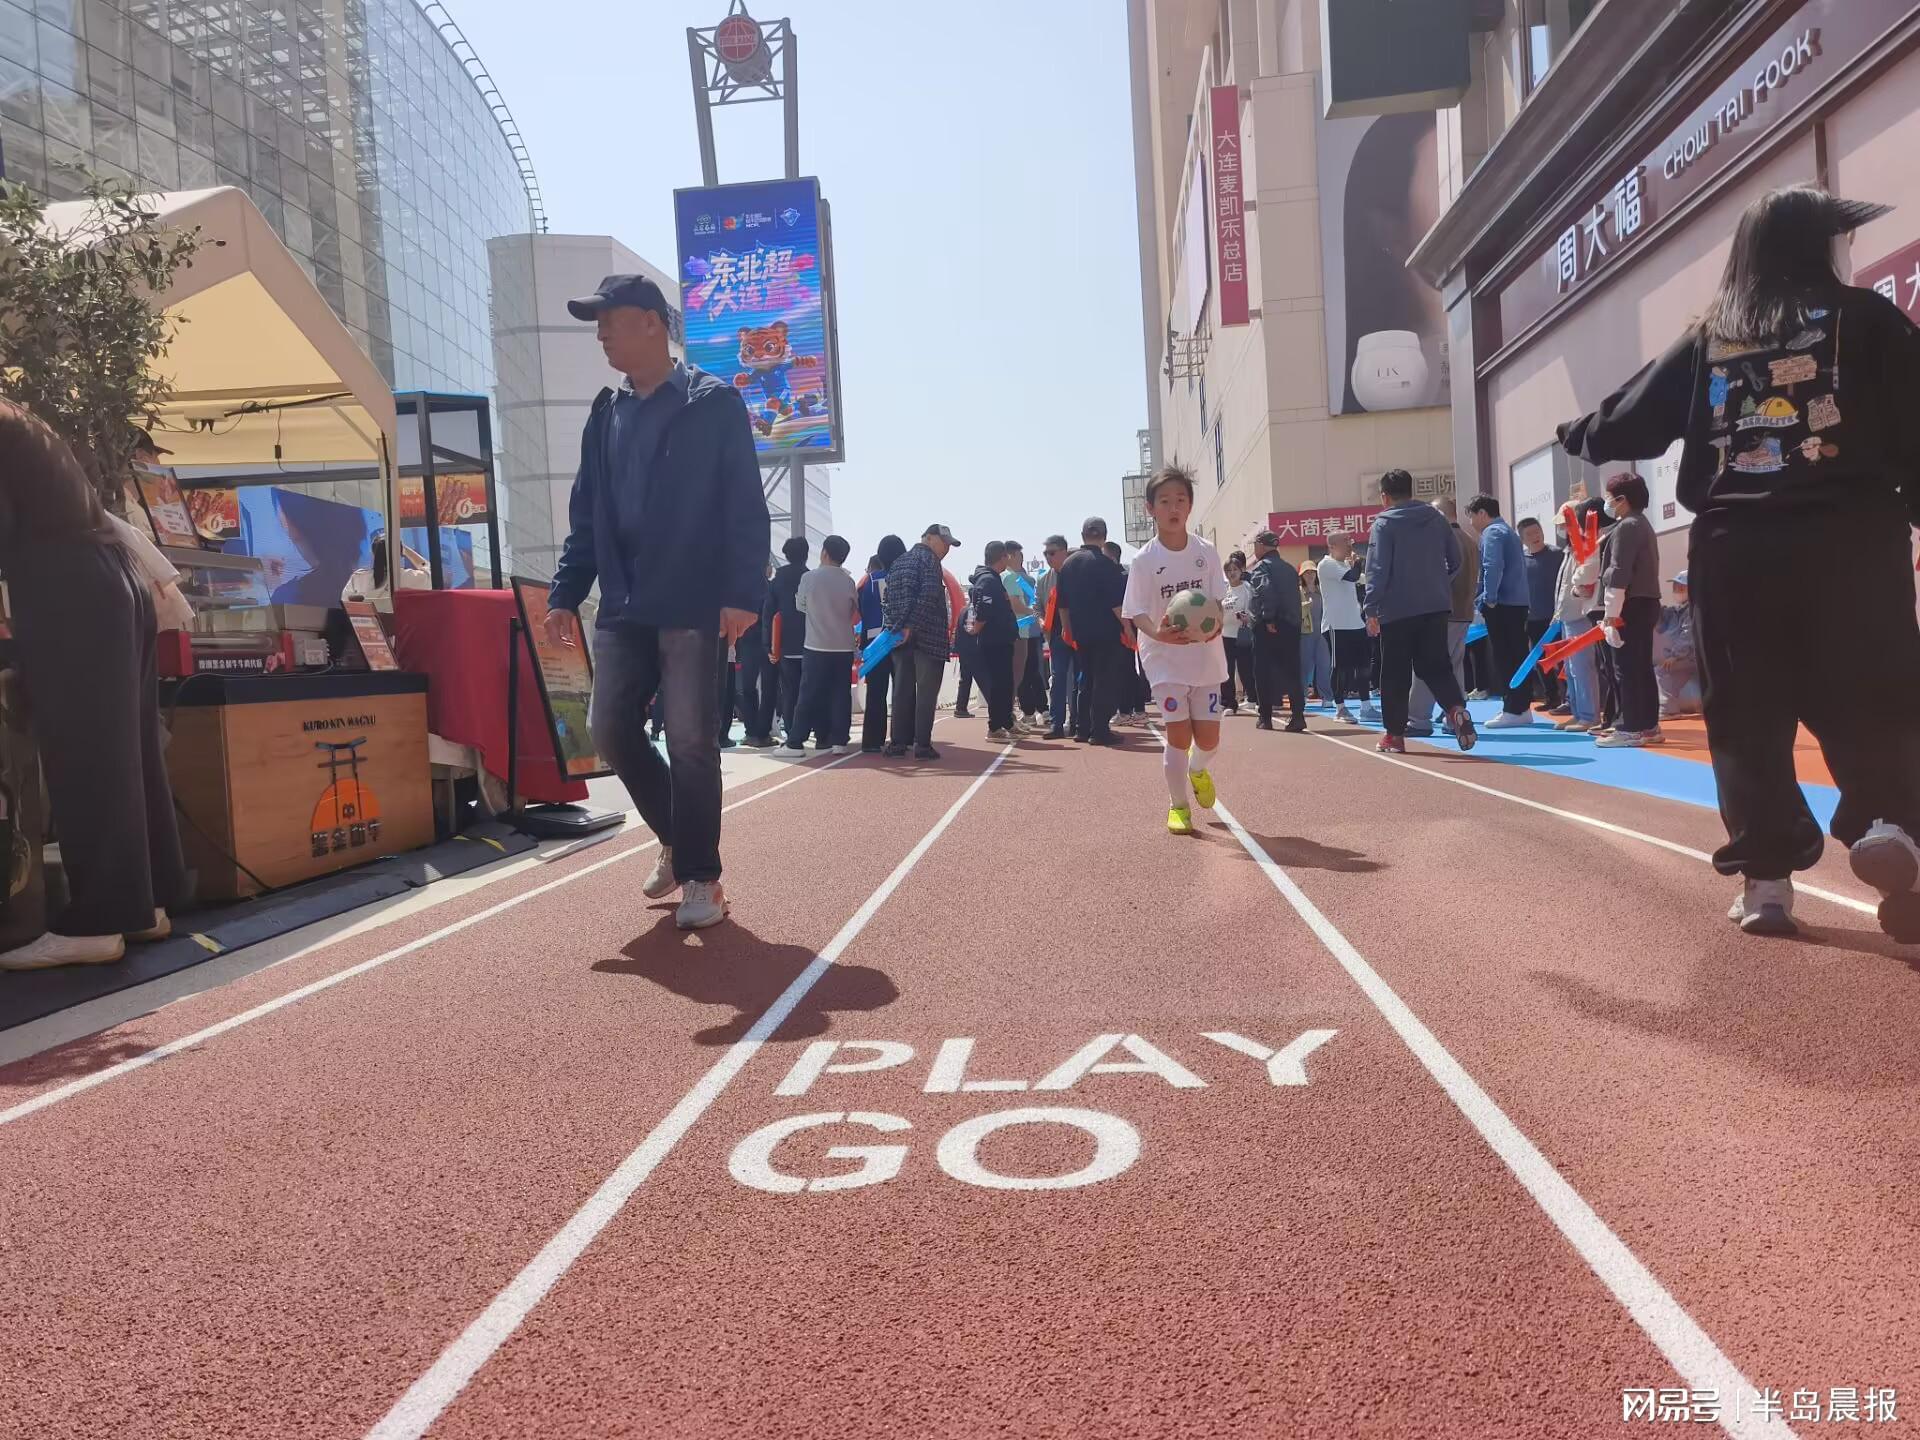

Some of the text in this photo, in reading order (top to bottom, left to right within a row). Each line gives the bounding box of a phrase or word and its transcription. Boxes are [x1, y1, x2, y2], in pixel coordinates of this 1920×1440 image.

[1664, 29, 1813, 180] CHOW TAI FOOK
[1217, 130, 1243, 282] 大连麦凯乐总店
[1557, 166, 1642, 294] 周大福
[701, 249, 793, 292] 东北超
[772, 1028, 1340, 1097] PLAY
[727, 1106, 1142, 1194] GO
